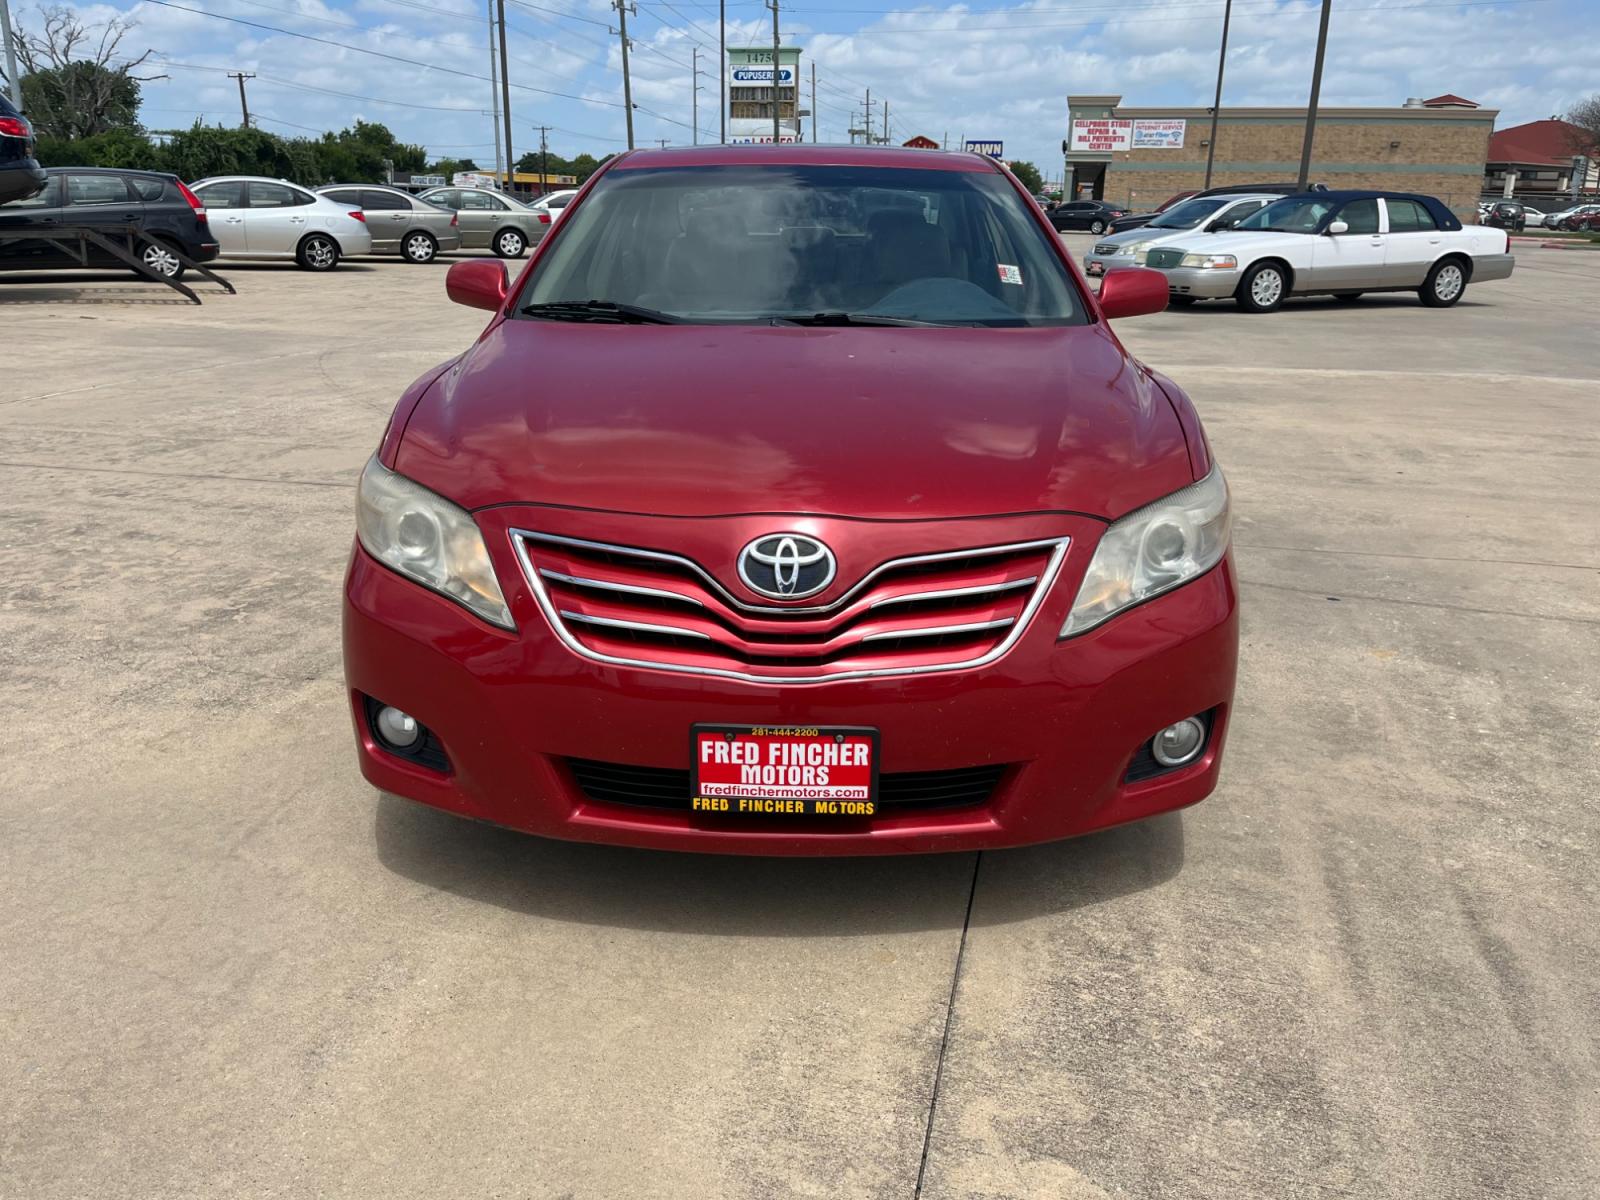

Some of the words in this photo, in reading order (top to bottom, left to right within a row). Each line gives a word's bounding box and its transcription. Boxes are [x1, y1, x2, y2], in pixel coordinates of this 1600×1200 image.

[738, 71, 775, 80] PUPUSERI
[1111, 120, 1131, 128] STORE
[967, 143, 1001, 154] PAWN
[752, 728, 819, 737] 281-444-2200
[701, 740, 759, 765] FRED
[768, 742, 869, 766] FINCHER
[741, 765, 830, 786] MOTORS
[703, 784, 865, 798] fredfinchermotors.com
[692, 798, 729, 811] FRED
[739, 799, 804, 813] FINCHER
[815, 801, 874, 815] MOTORS
